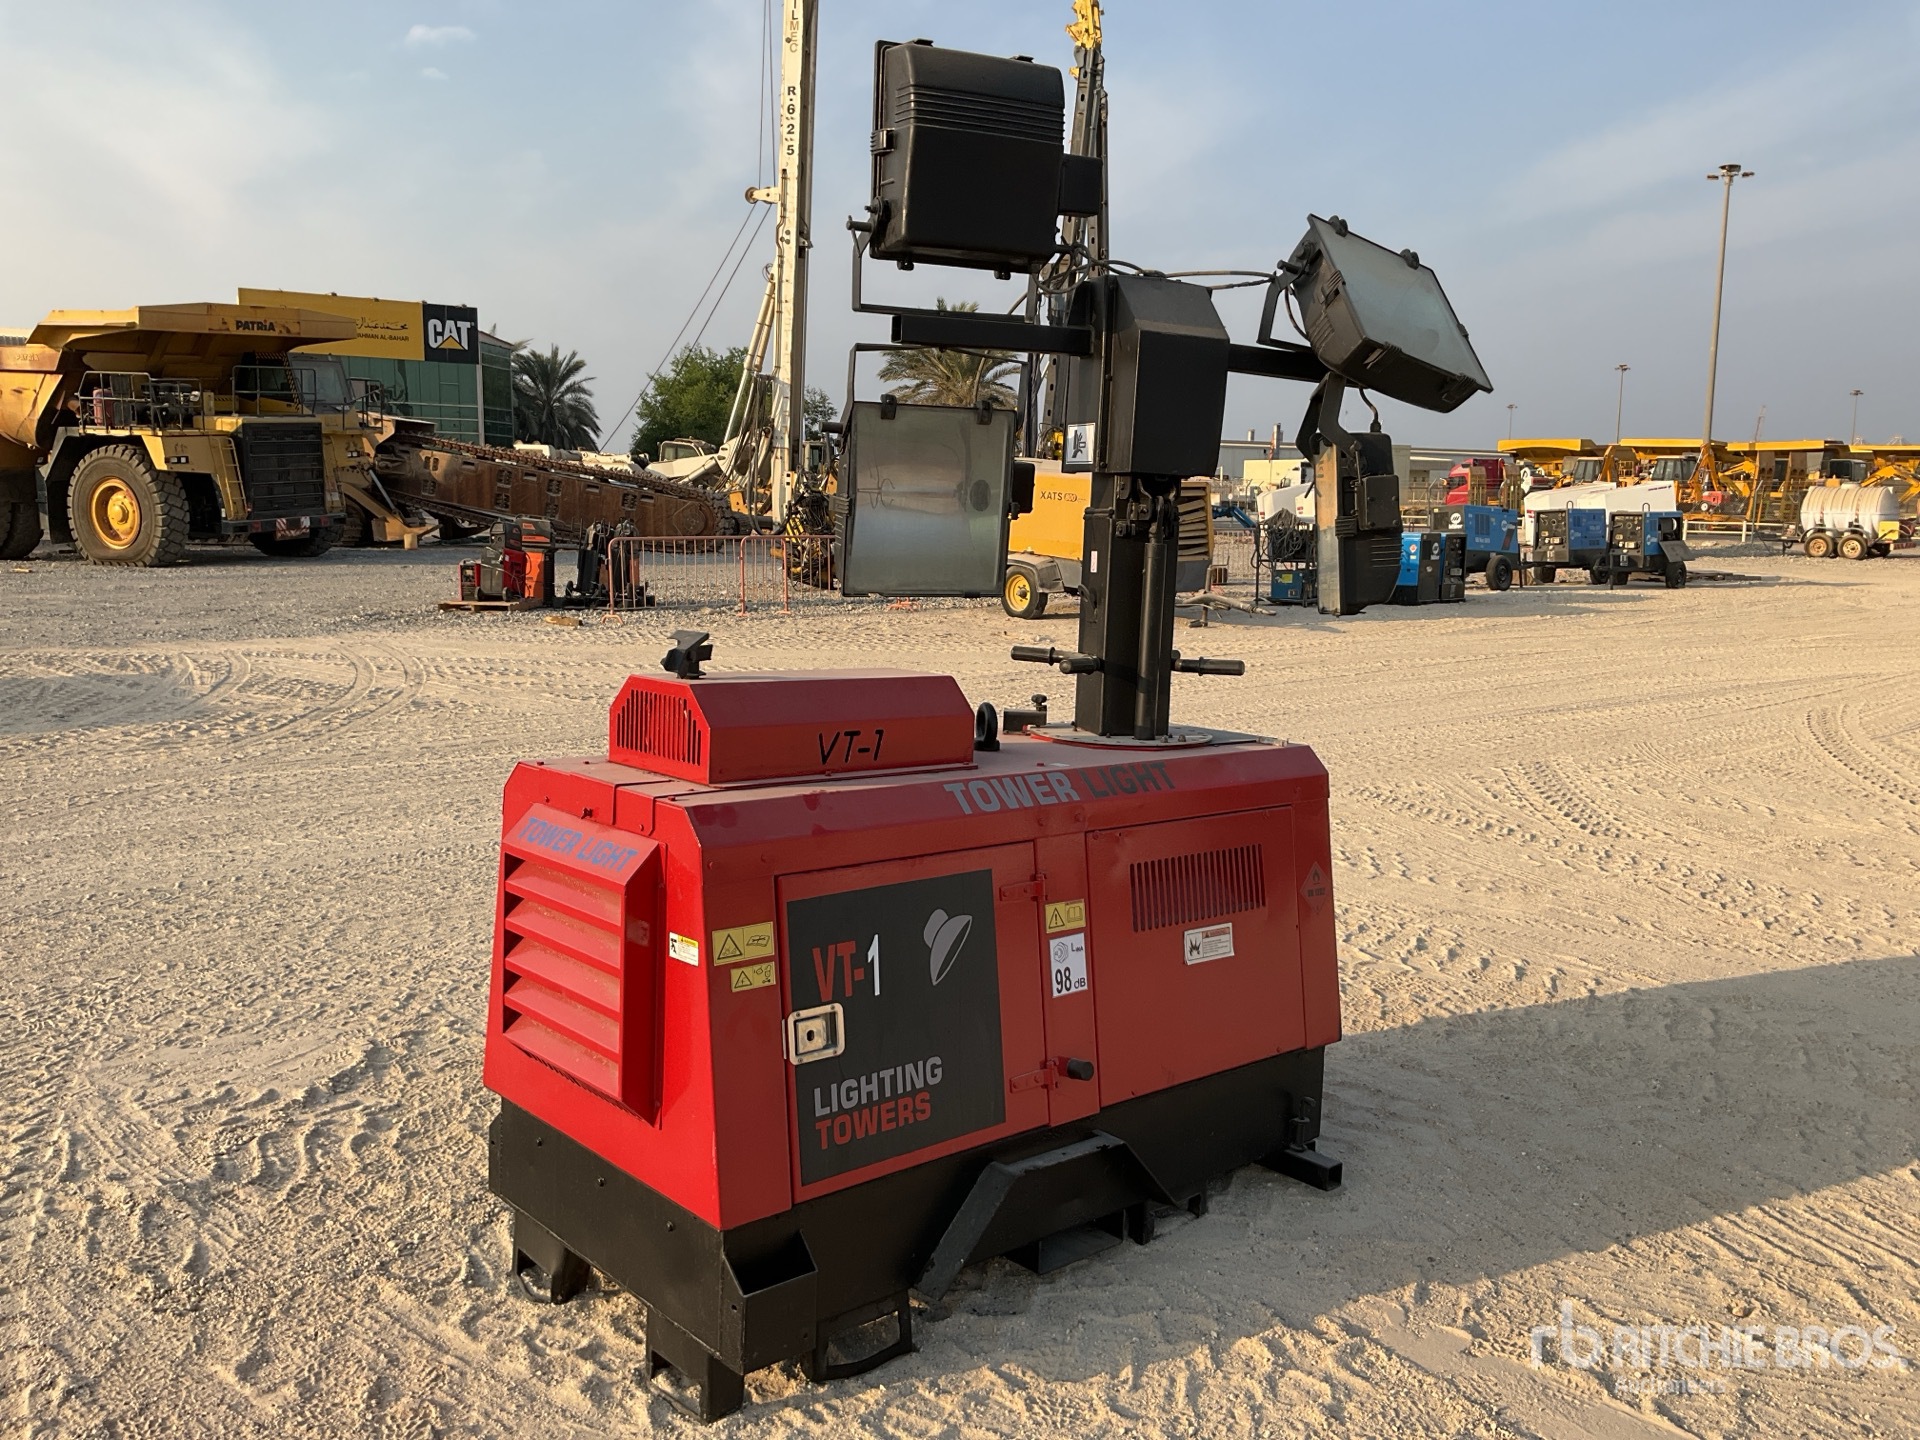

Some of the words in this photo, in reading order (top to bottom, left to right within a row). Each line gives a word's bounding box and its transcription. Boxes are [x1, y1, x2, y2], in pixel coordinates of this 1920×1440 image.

[380, 334, 410, 342] AL-BAHAR
[428, 318, 470, 350] CAT
[1040, 490, 1063, 501] XATS
[819, 729, 884, 765] VT-1
[943, 771, 1080, 815] TOWER
[1078, 761, 1176, 798] LIGHT
[518, 817, 583, 855] TOWER
[576, 836, 638, 872] LIGHT
[812, 933, 880, 1002] VT-1
[1055, 966, 1072, 994] 98
[1073, 977, 1086, 989] dB
[814, 1056, 942, 1117] LIGHTING
[815, 1091, 931, 1150] TOWERS
